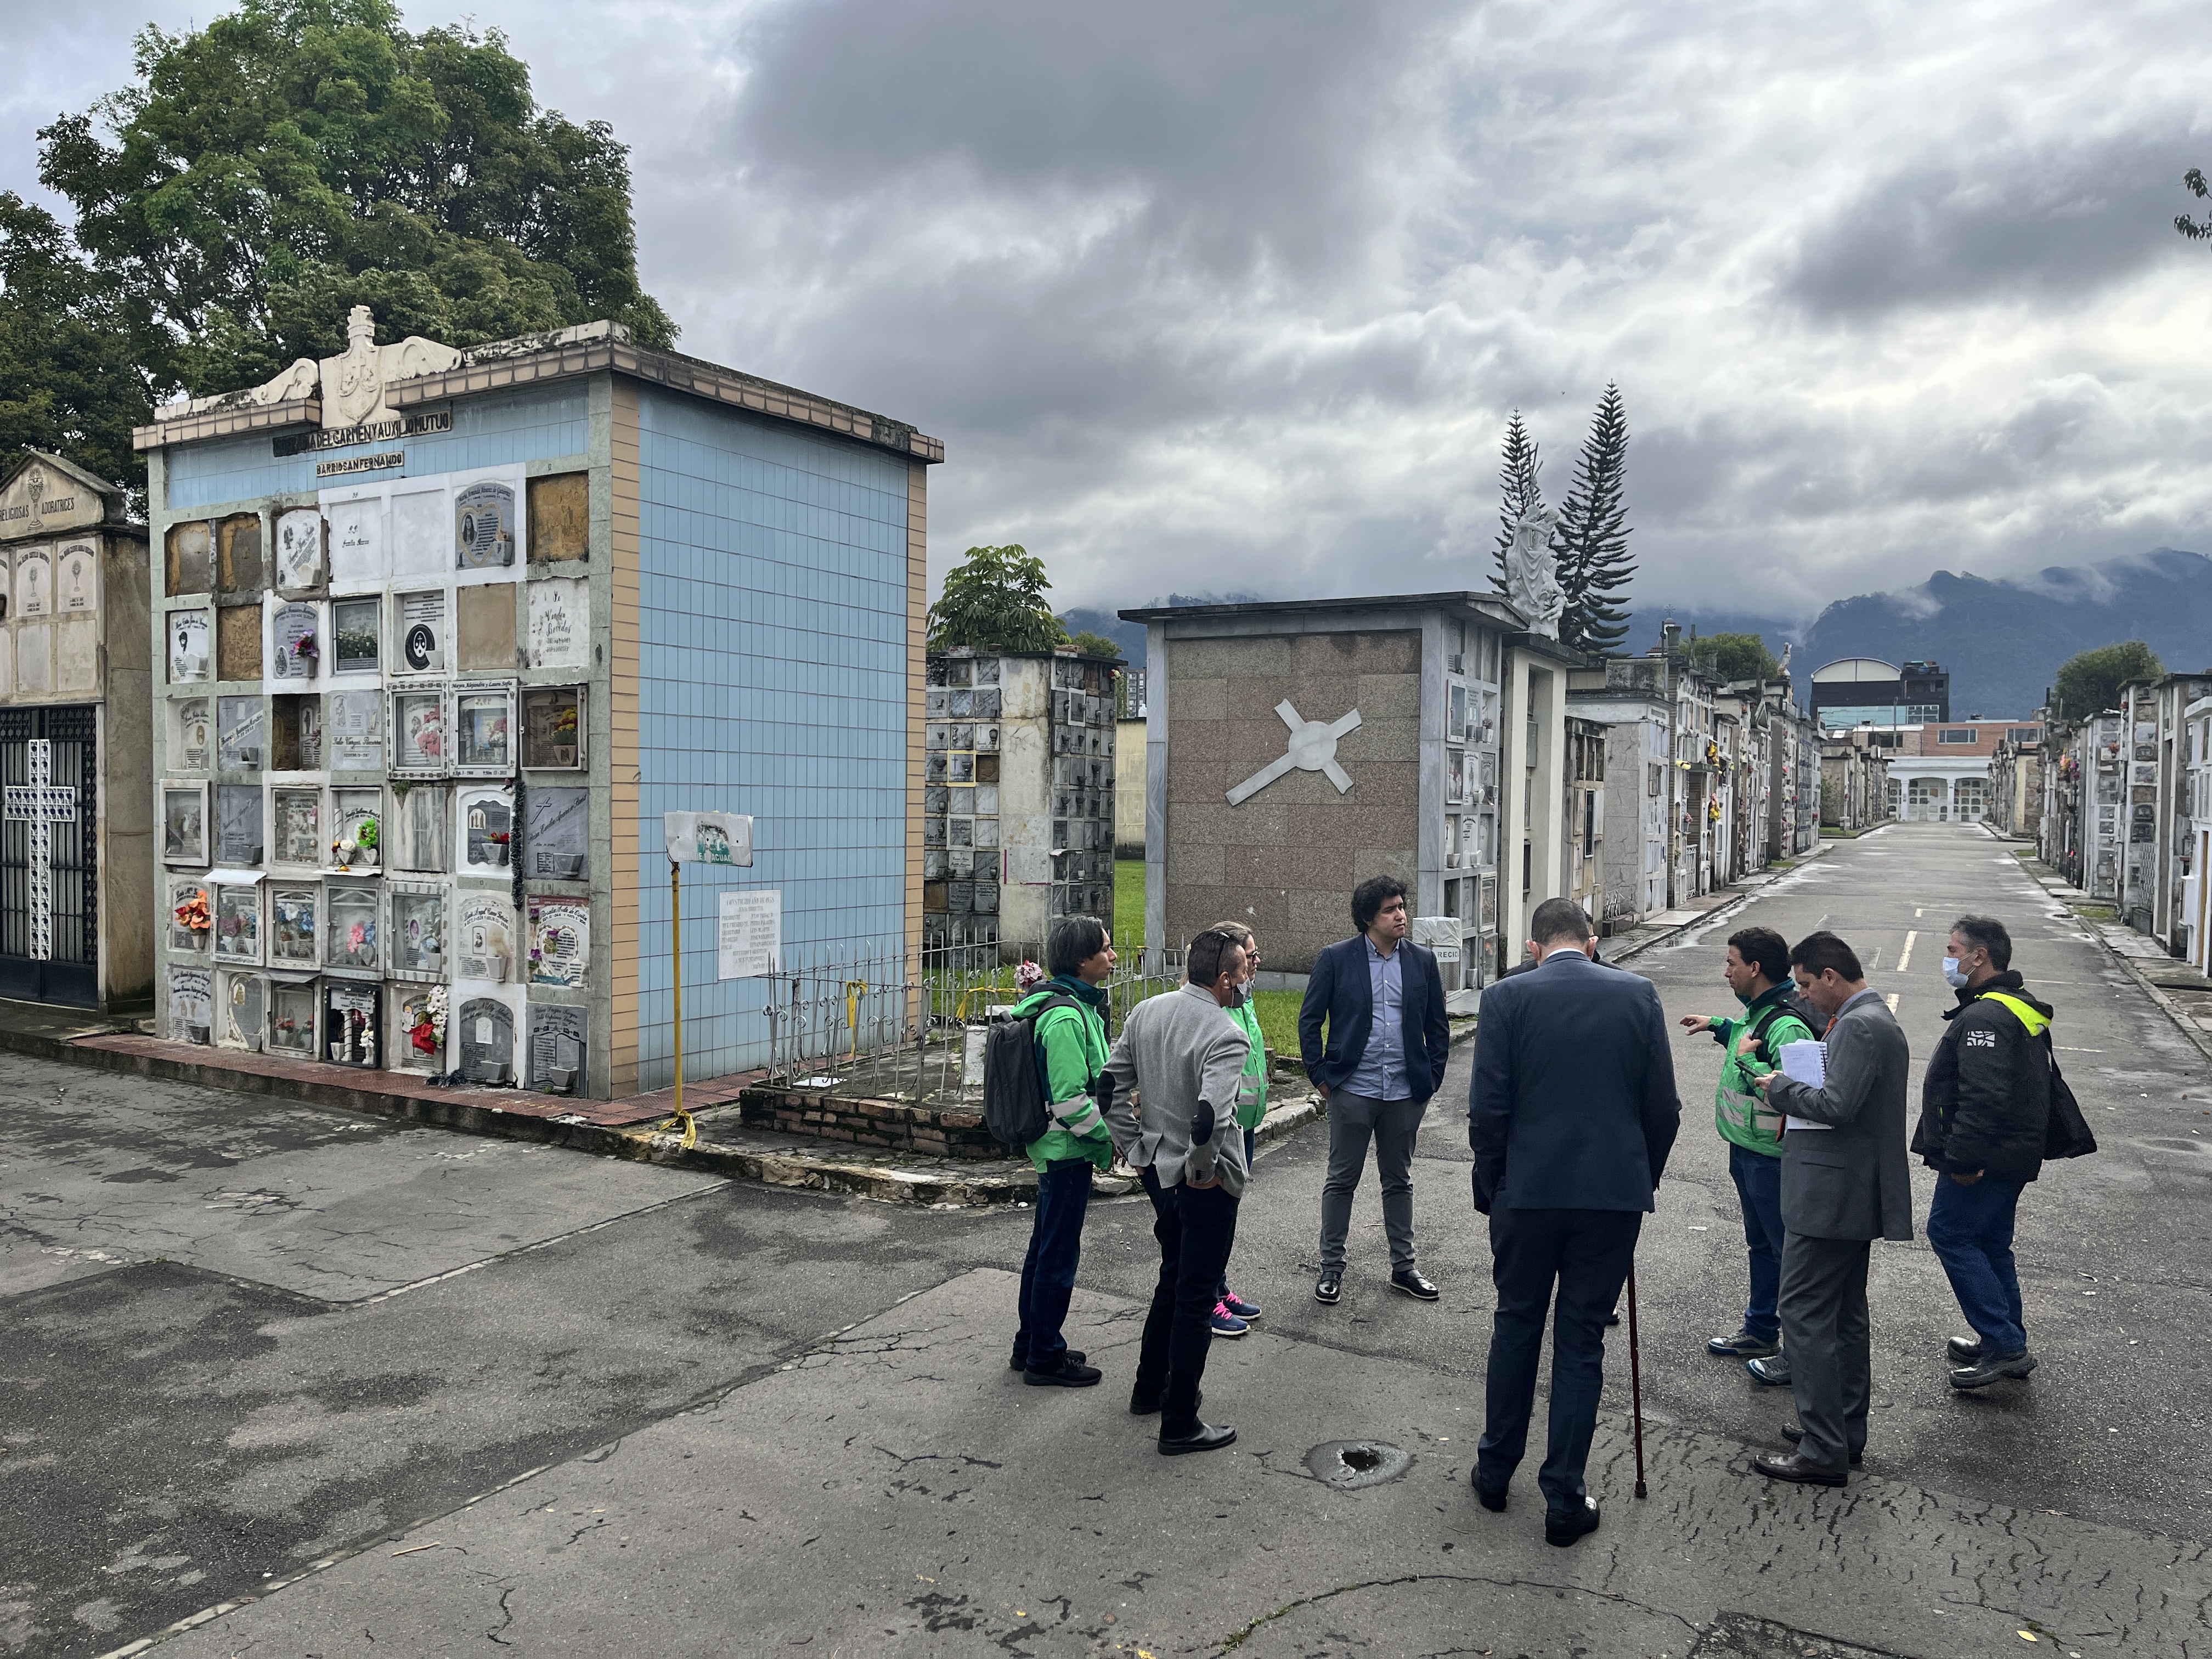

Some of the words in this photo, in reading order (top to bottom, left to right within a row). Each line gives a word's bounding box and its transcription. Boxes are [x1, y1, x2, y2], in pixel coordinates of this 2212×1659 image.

[414, 413, 449, 433] MUTUO
[317, 461, 343, 475] BARRIO
[343, 460, 359, 471] SAN
[359, 454, 402, 469] FERNANDO
[41, 497, 75, 515] ADORATRICES
